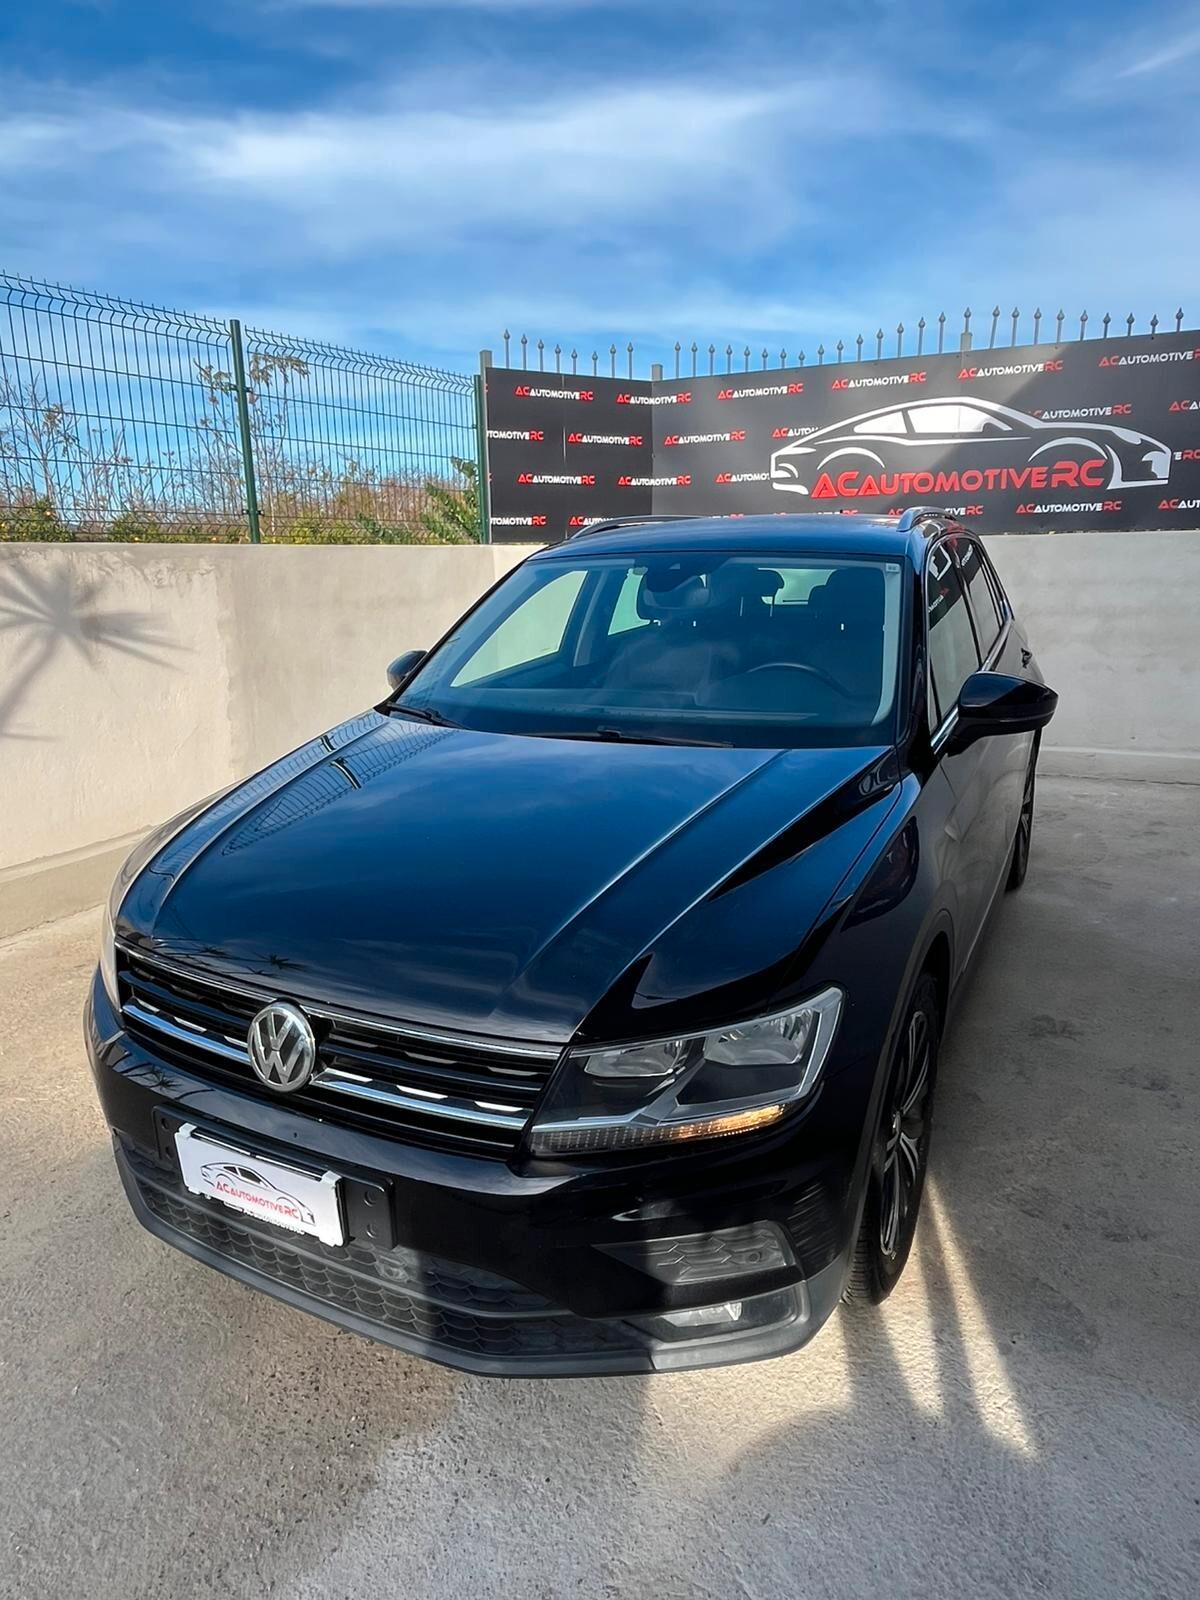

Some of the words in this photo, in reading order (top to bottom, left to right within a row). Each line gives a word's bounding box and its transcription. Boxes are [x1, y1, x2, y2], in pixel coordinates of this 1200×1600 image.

[958, 360, 1064, 380] ACAUTOMOTIVERC
[832, 372, 927, 390] ACAUTOMOTIVERC
[515, 386, 594, 400] ACAUTOMOTIVERC
[617, 392, 692, 405] ACAUTOMOTIVERC
[718, 383, 804, 400] ACAUTOMOTIVERC
[568, 433, 643, 445] ACAUTOMOTIVERC
[664, 431, 746, 445] ACAUTOMOTIVERC
[518, 473, 598, 485] ACAUTOMOTIVERC
[618, 475, 692, 486] ACAUTOMOTIVERC
[812, 459, 1107, 498] ACAUTOMOTIVERC
[1016, 501, 1123, 514] ACAUTOMOTIVERC
[216, 1181, 300, 1220] ACAUTOMOTIVERC
